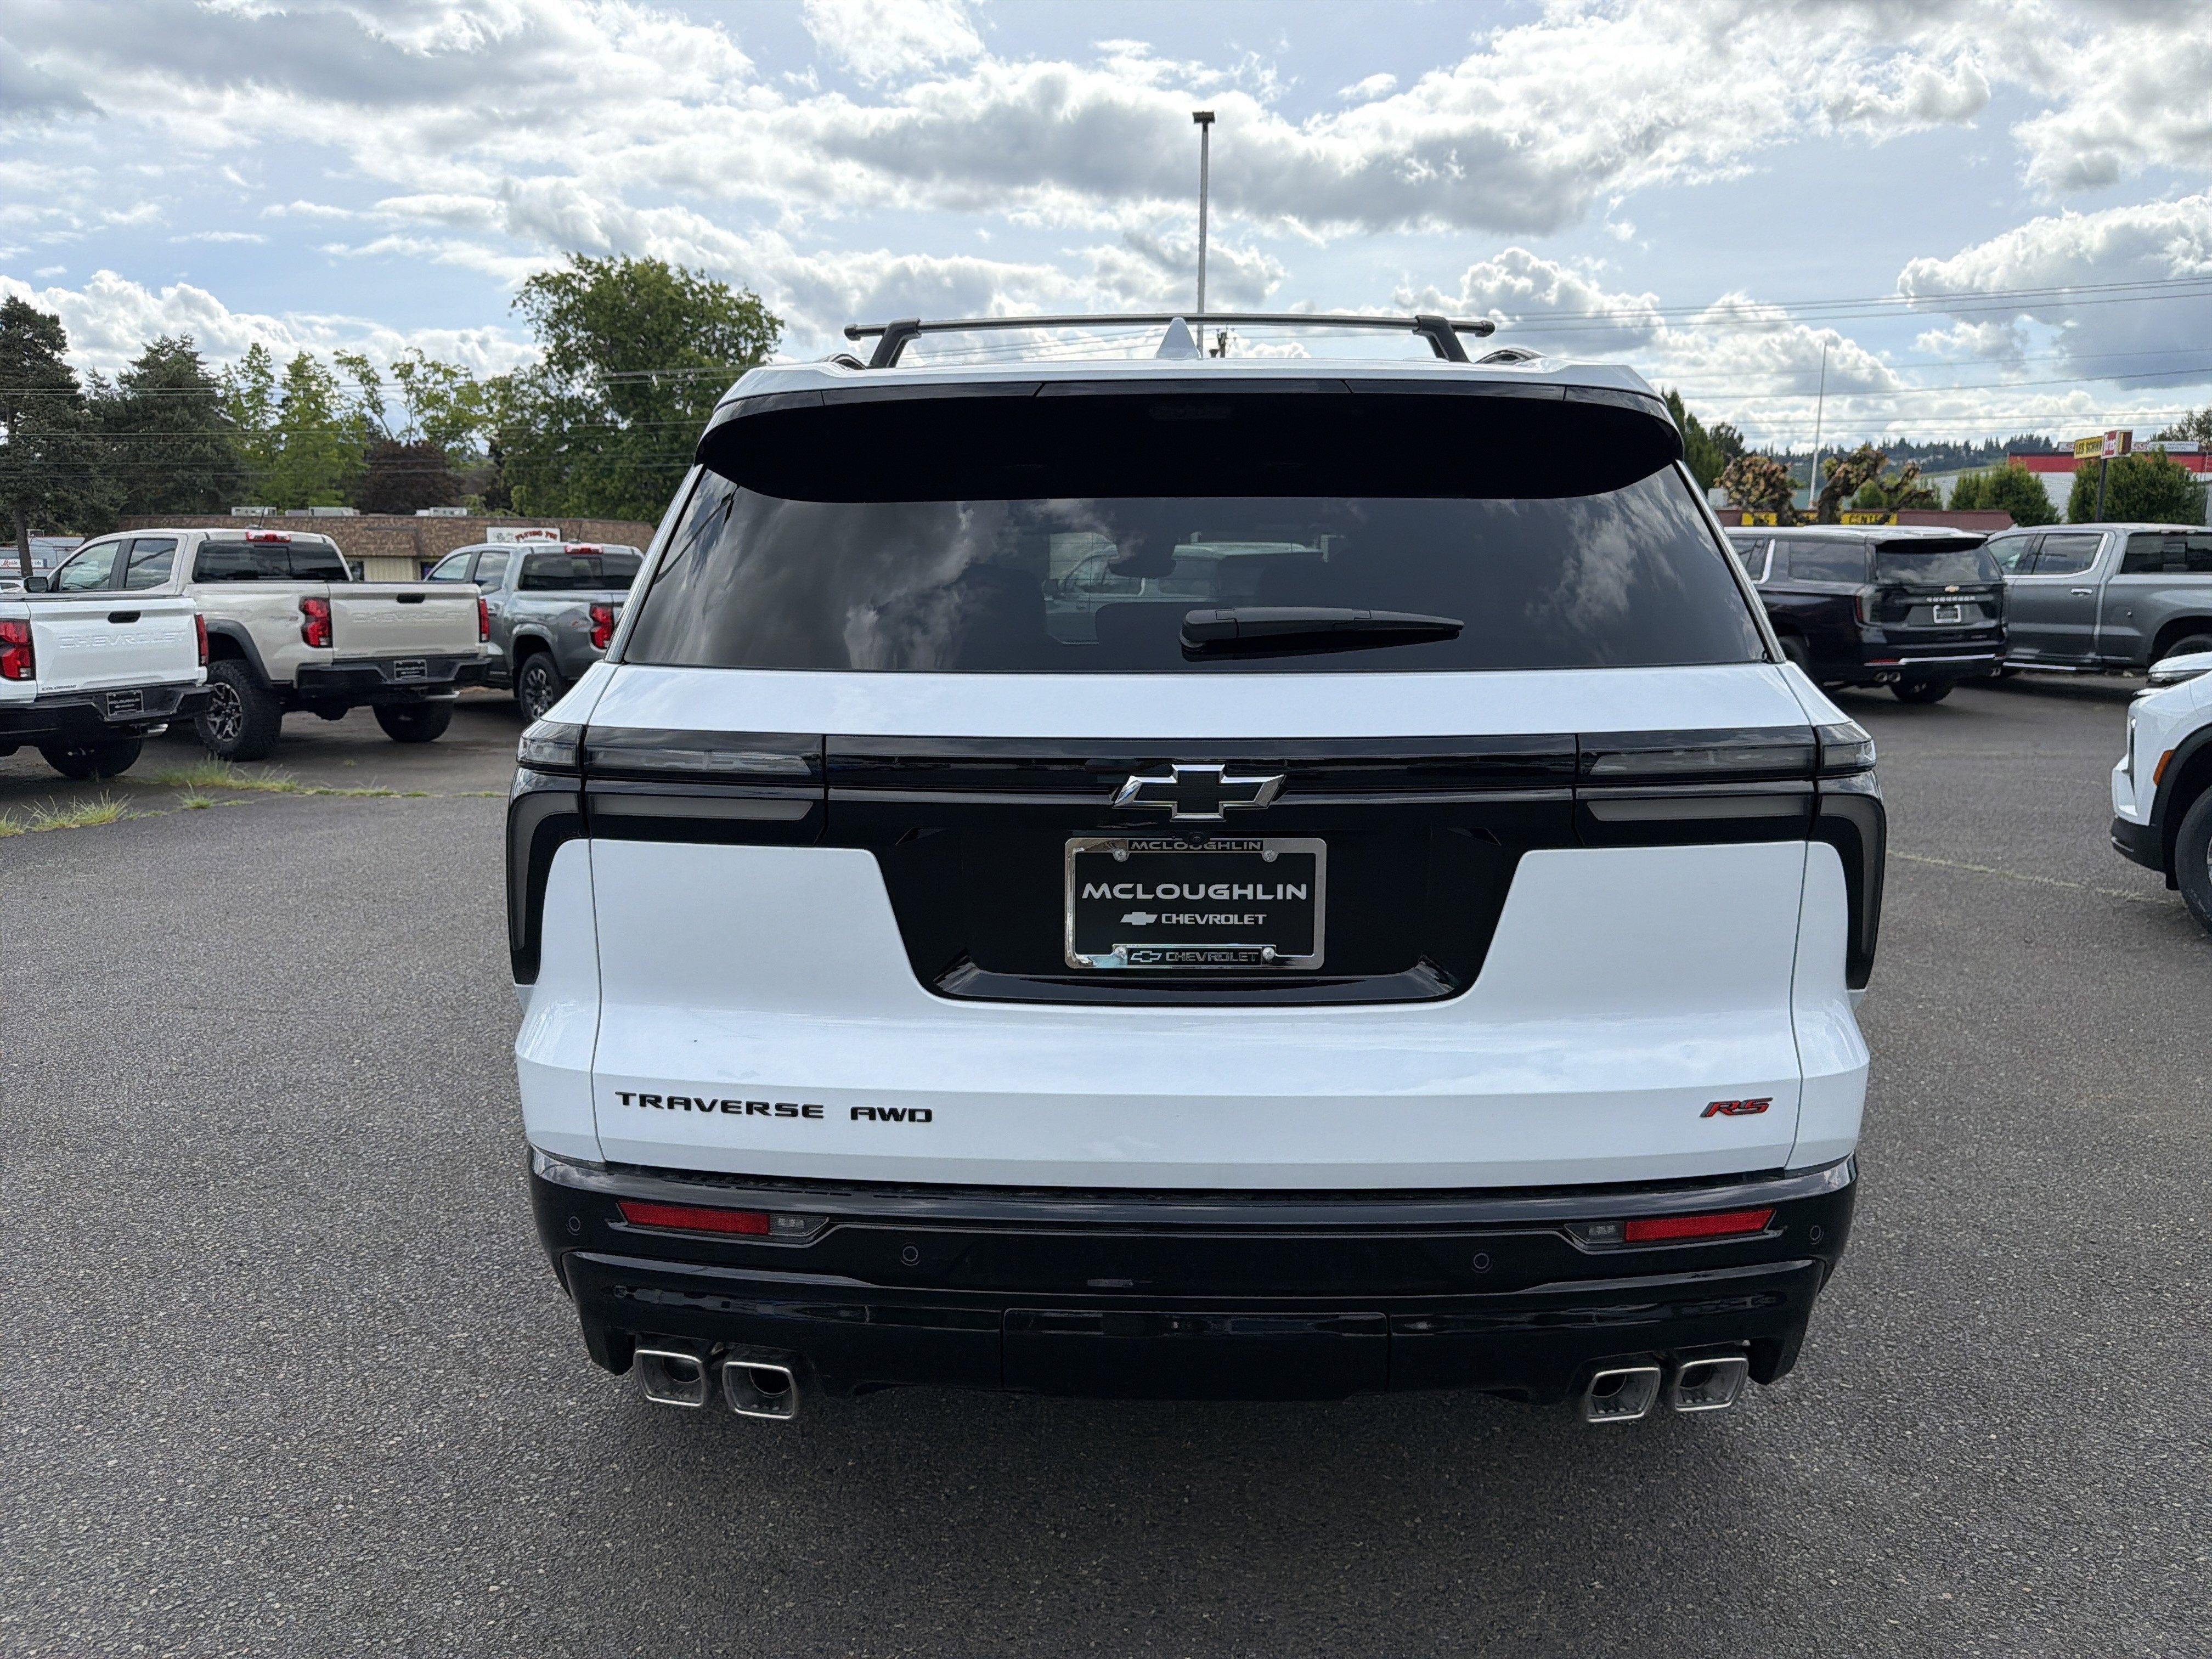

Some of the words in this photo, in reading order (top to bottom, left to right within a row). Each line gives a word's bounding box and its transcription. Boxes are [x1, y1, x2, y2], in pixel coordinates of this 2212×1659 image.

[58, 631, 187, 648] CHEVROLET
[1130, 841, 1261, 850] MCLOUGHLIN
[1082, 883, 1307, 900] MCLOUGHLIN
[1161, 913, 1267, 926] CHEVROLET
[1166, 952, 1259, 962] CHEVROLET
[614, 1091, 824, 1119] TRAVERSE
[850, 1105, 933, 1123] AWD
[1700, 1097, 1774, 1118] RS
